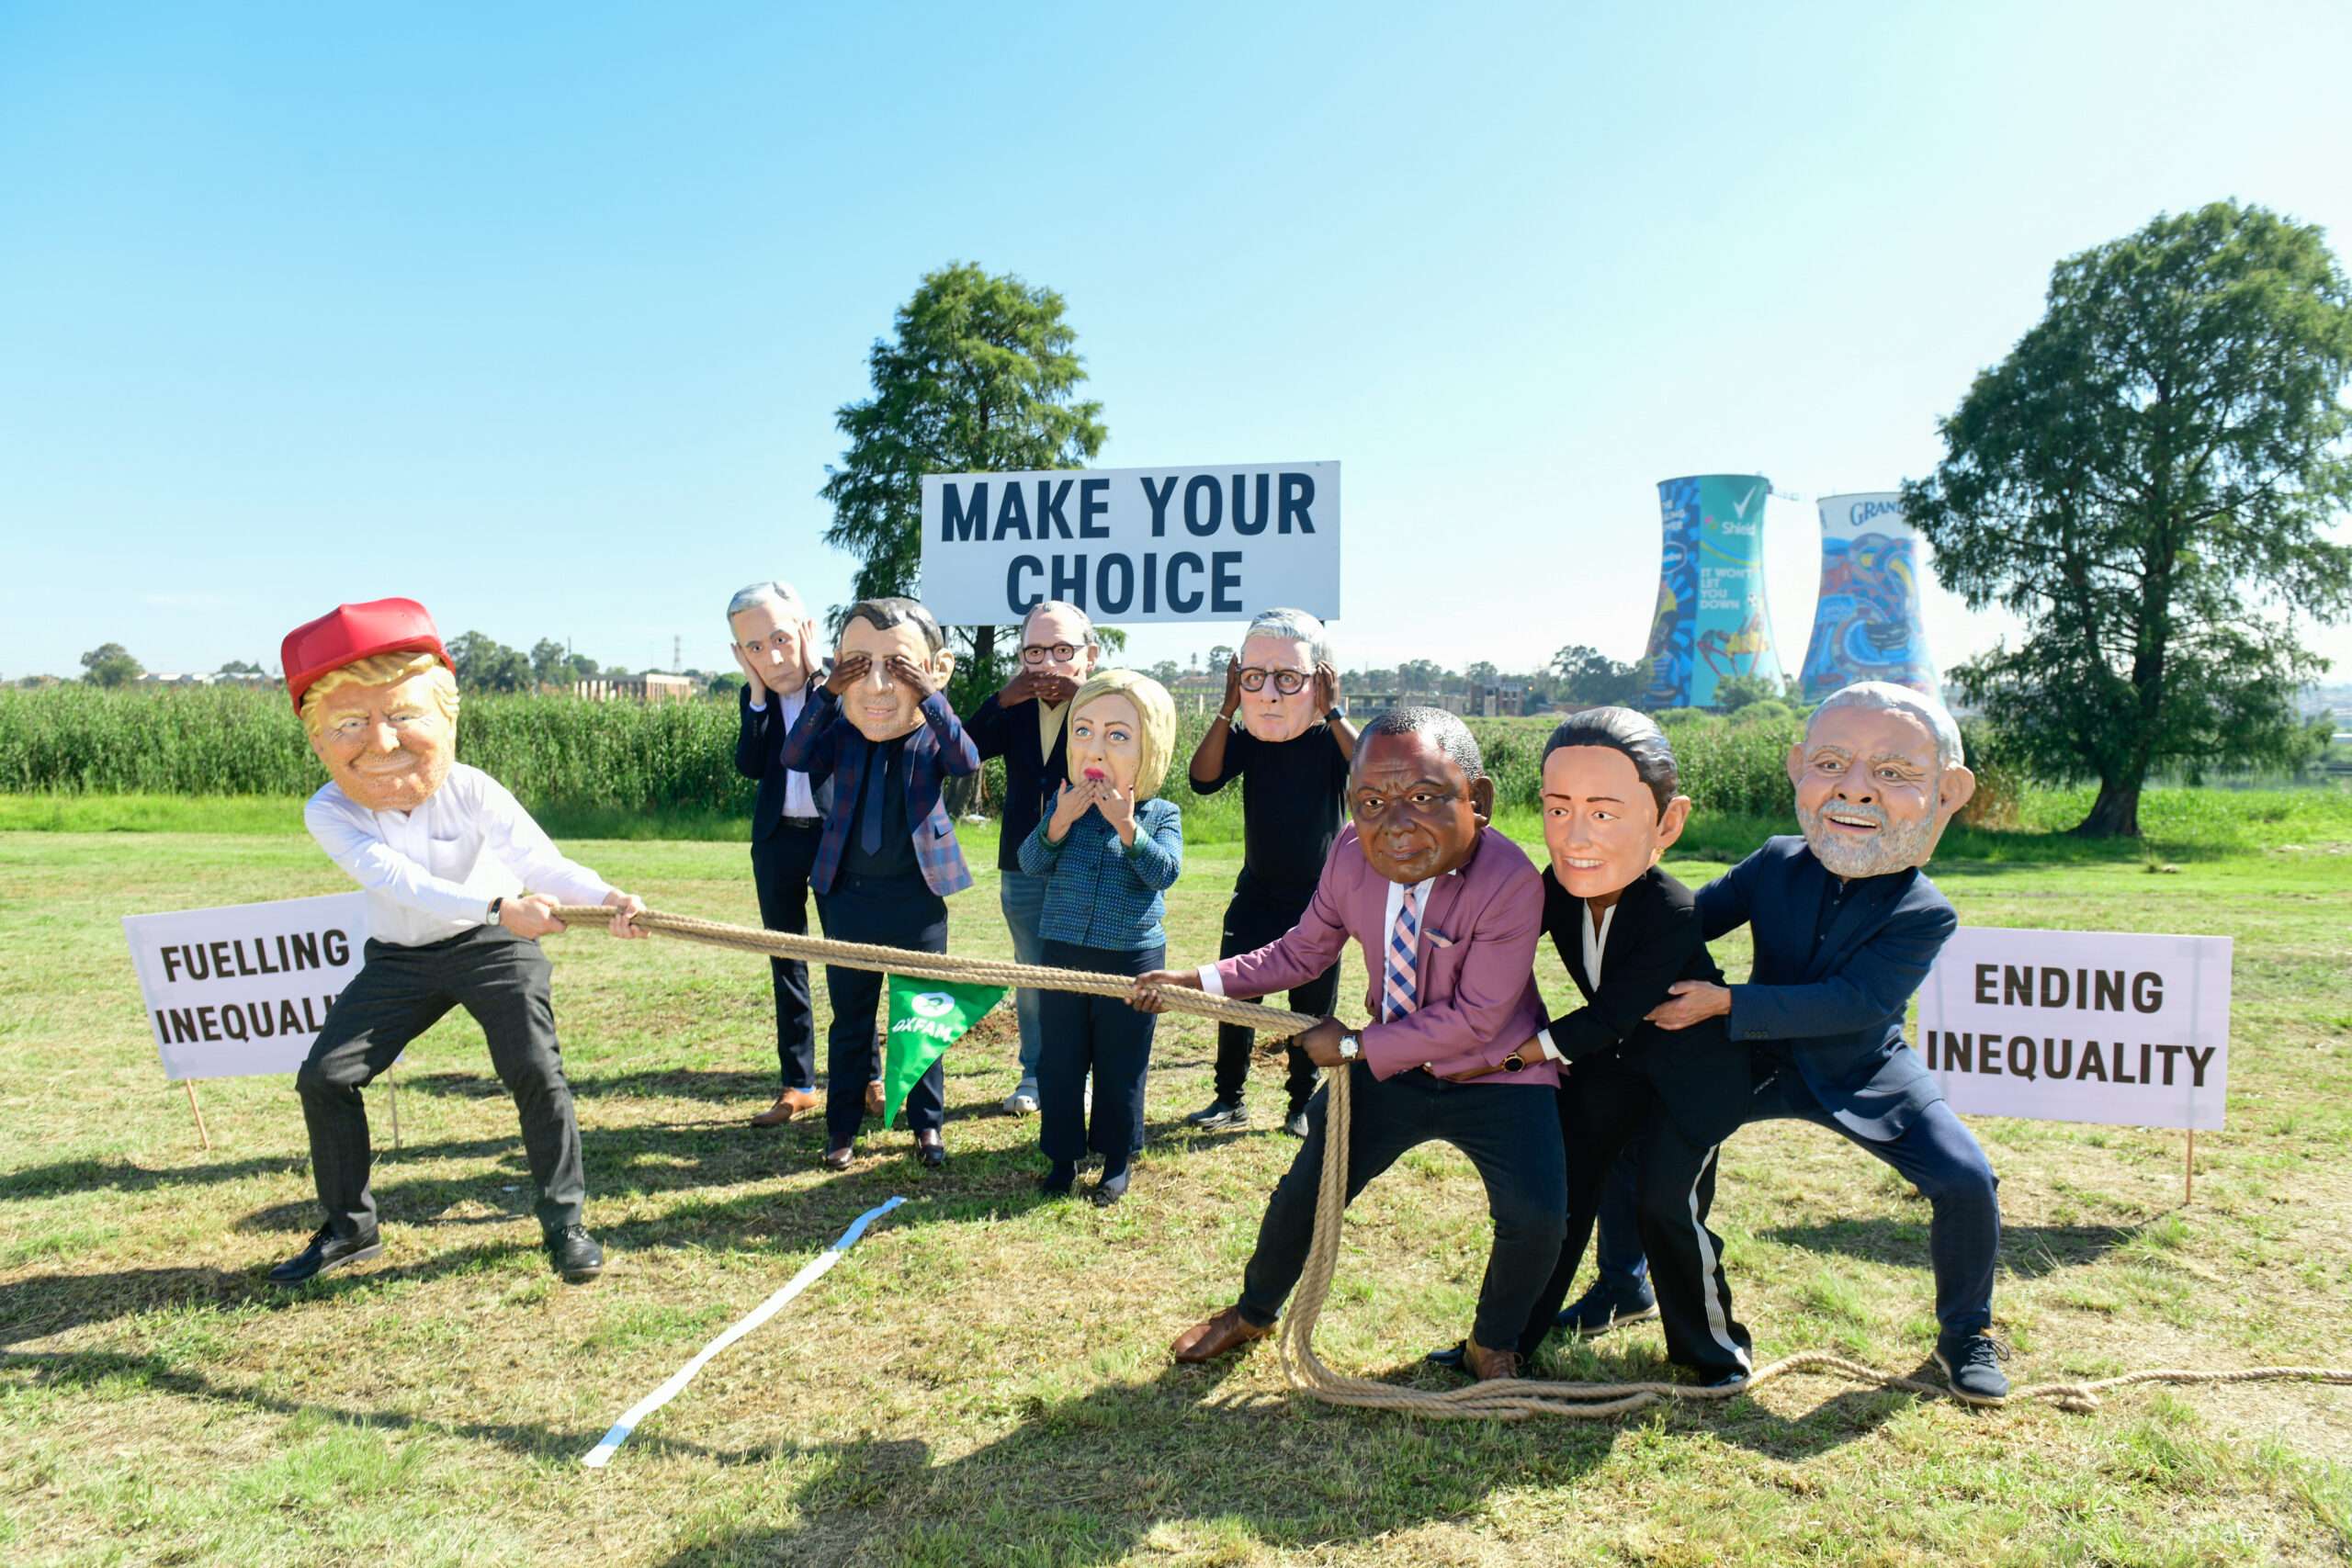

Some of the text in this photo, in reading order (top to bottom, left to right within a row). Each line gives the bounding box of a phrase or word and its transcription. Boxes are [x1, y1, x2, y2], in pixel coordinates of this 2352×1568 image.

[941, 472, 1317, 542] MAKE YOUR
[1007, 551, 1243, 615] CHOICE
[1700, 600, 1739, 610] DOWN
[1701, 578, 1720, 588] LET
[1701, 589, 1727, 599] YOU
[160, 929, 351, 983] FUELLING
[1975, 964, 2164, 1013] ENDING
[155, 994, 340, 1044] INEQUAL
[892, 1017, 954, 1043] OXFAM
[1928, 1030, 2216, 1088] INEQUALITY
